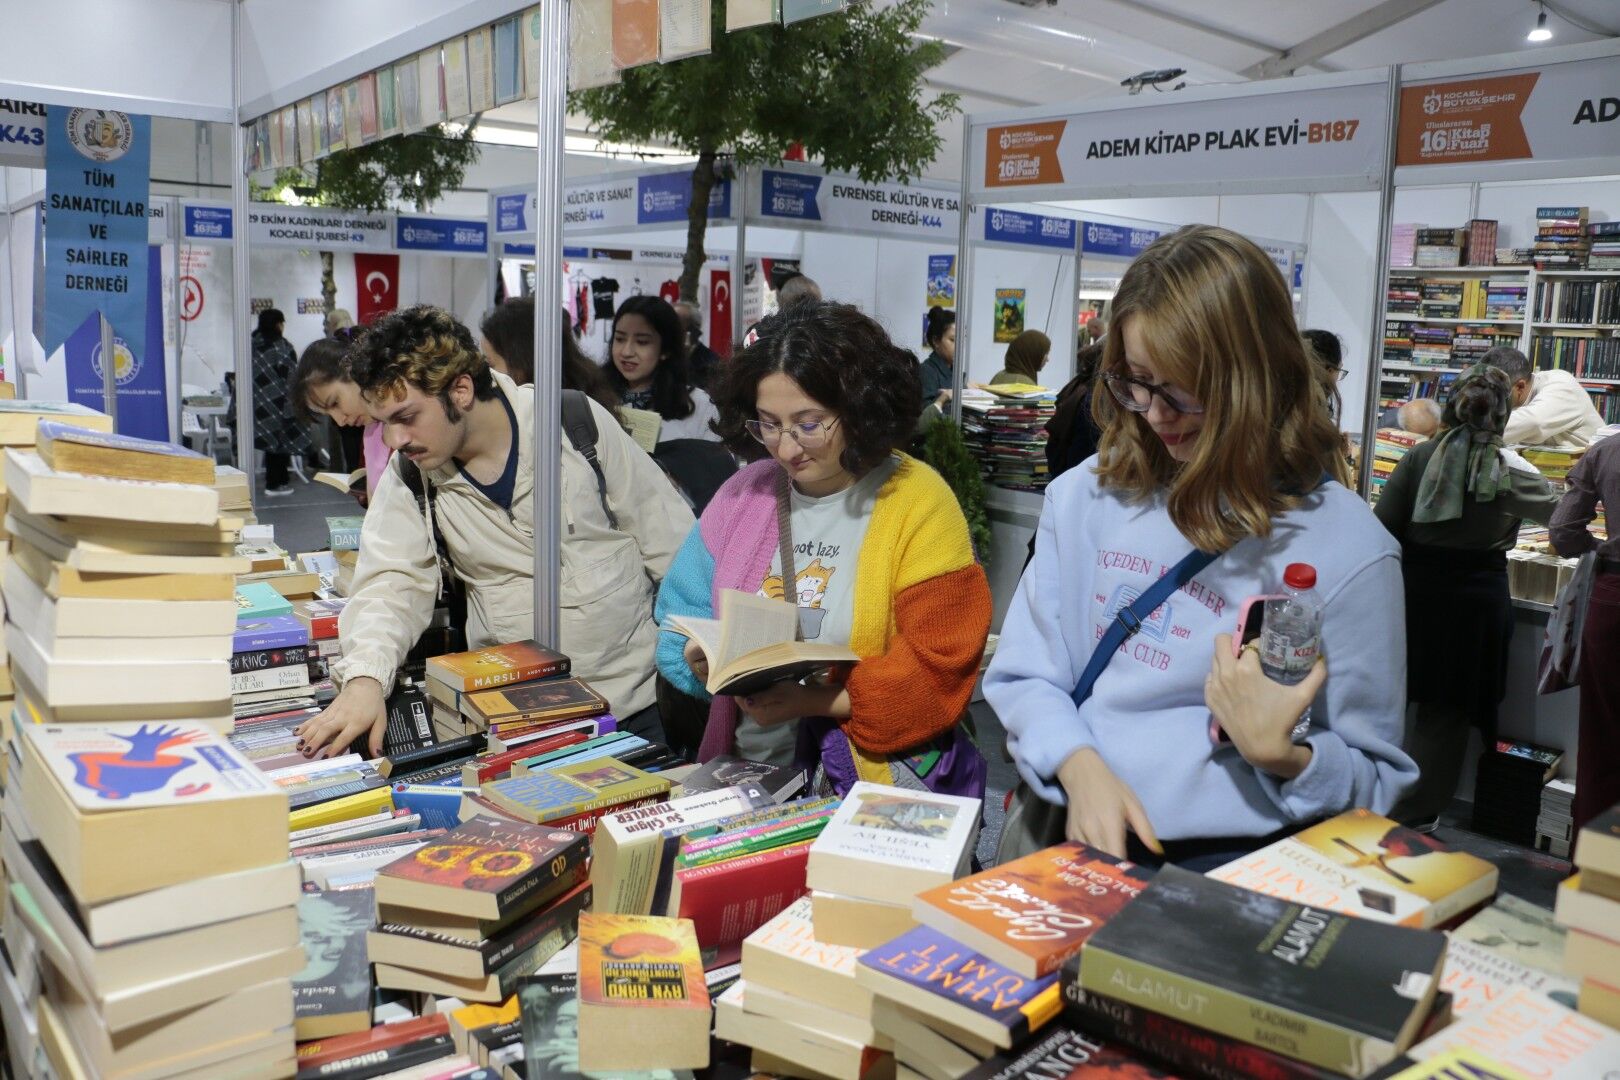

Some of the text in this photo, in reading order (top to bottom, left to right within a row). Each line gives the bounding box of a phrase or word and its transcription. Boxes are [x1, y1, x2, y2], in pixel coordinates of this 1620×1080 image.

[1086, 118, 1359, 159] ADEM KİTAP PLAK EVİ-B187
[83, 167, 115, 188] TÜM
[596, 191, 605, 202] VE
[607, 187, 633, 201] SANAT
[832, 185, 888, 203] EVRENSEL
[890, 191, 929, 208] KÜLTÜR
[931, 198, 944, 209] VE
[51, 194, 144, 218] SANATÇILAR
[261, 213, 286, 225] EKİM
[288, 216, 343, 228] KADINLARI
[346, 218, 387, 230] DERNEĞİ
[872, 209, 942, 228] DERNEĞİ-K44
[90, 224, 107, 240] VE
[269, 228, 314, 240] KOCAELİ
[66, 274, 128, 293] DERNEĞİ
[334, 534, 357, 546] DAN
[1170, 625, 1191, 639] 2021
[1096, 624, 1171, 671] BK CLUB
[242, 653, 268, 669] KING
[474, 671, 520, 687] MARSLI
[393, 769, 436, 786] TEPHEN
[578, 816, 597, 832] ÜMİT
[668, 813, 685, 829] Şu
[551, 856, 567, 878] OD
[683, 863, 721, 880] AGATHA
[1271, 907, 1332, 965] ALAMUT
[880, 951, 1022, 1012] AHMET
[1110, 967, 1209, 1013] ALAMUT
[302, 985, 337, 996] Sevda
[652, 983, 683, 999] AYN
[320, 1050, 390, 1074] Chicago
